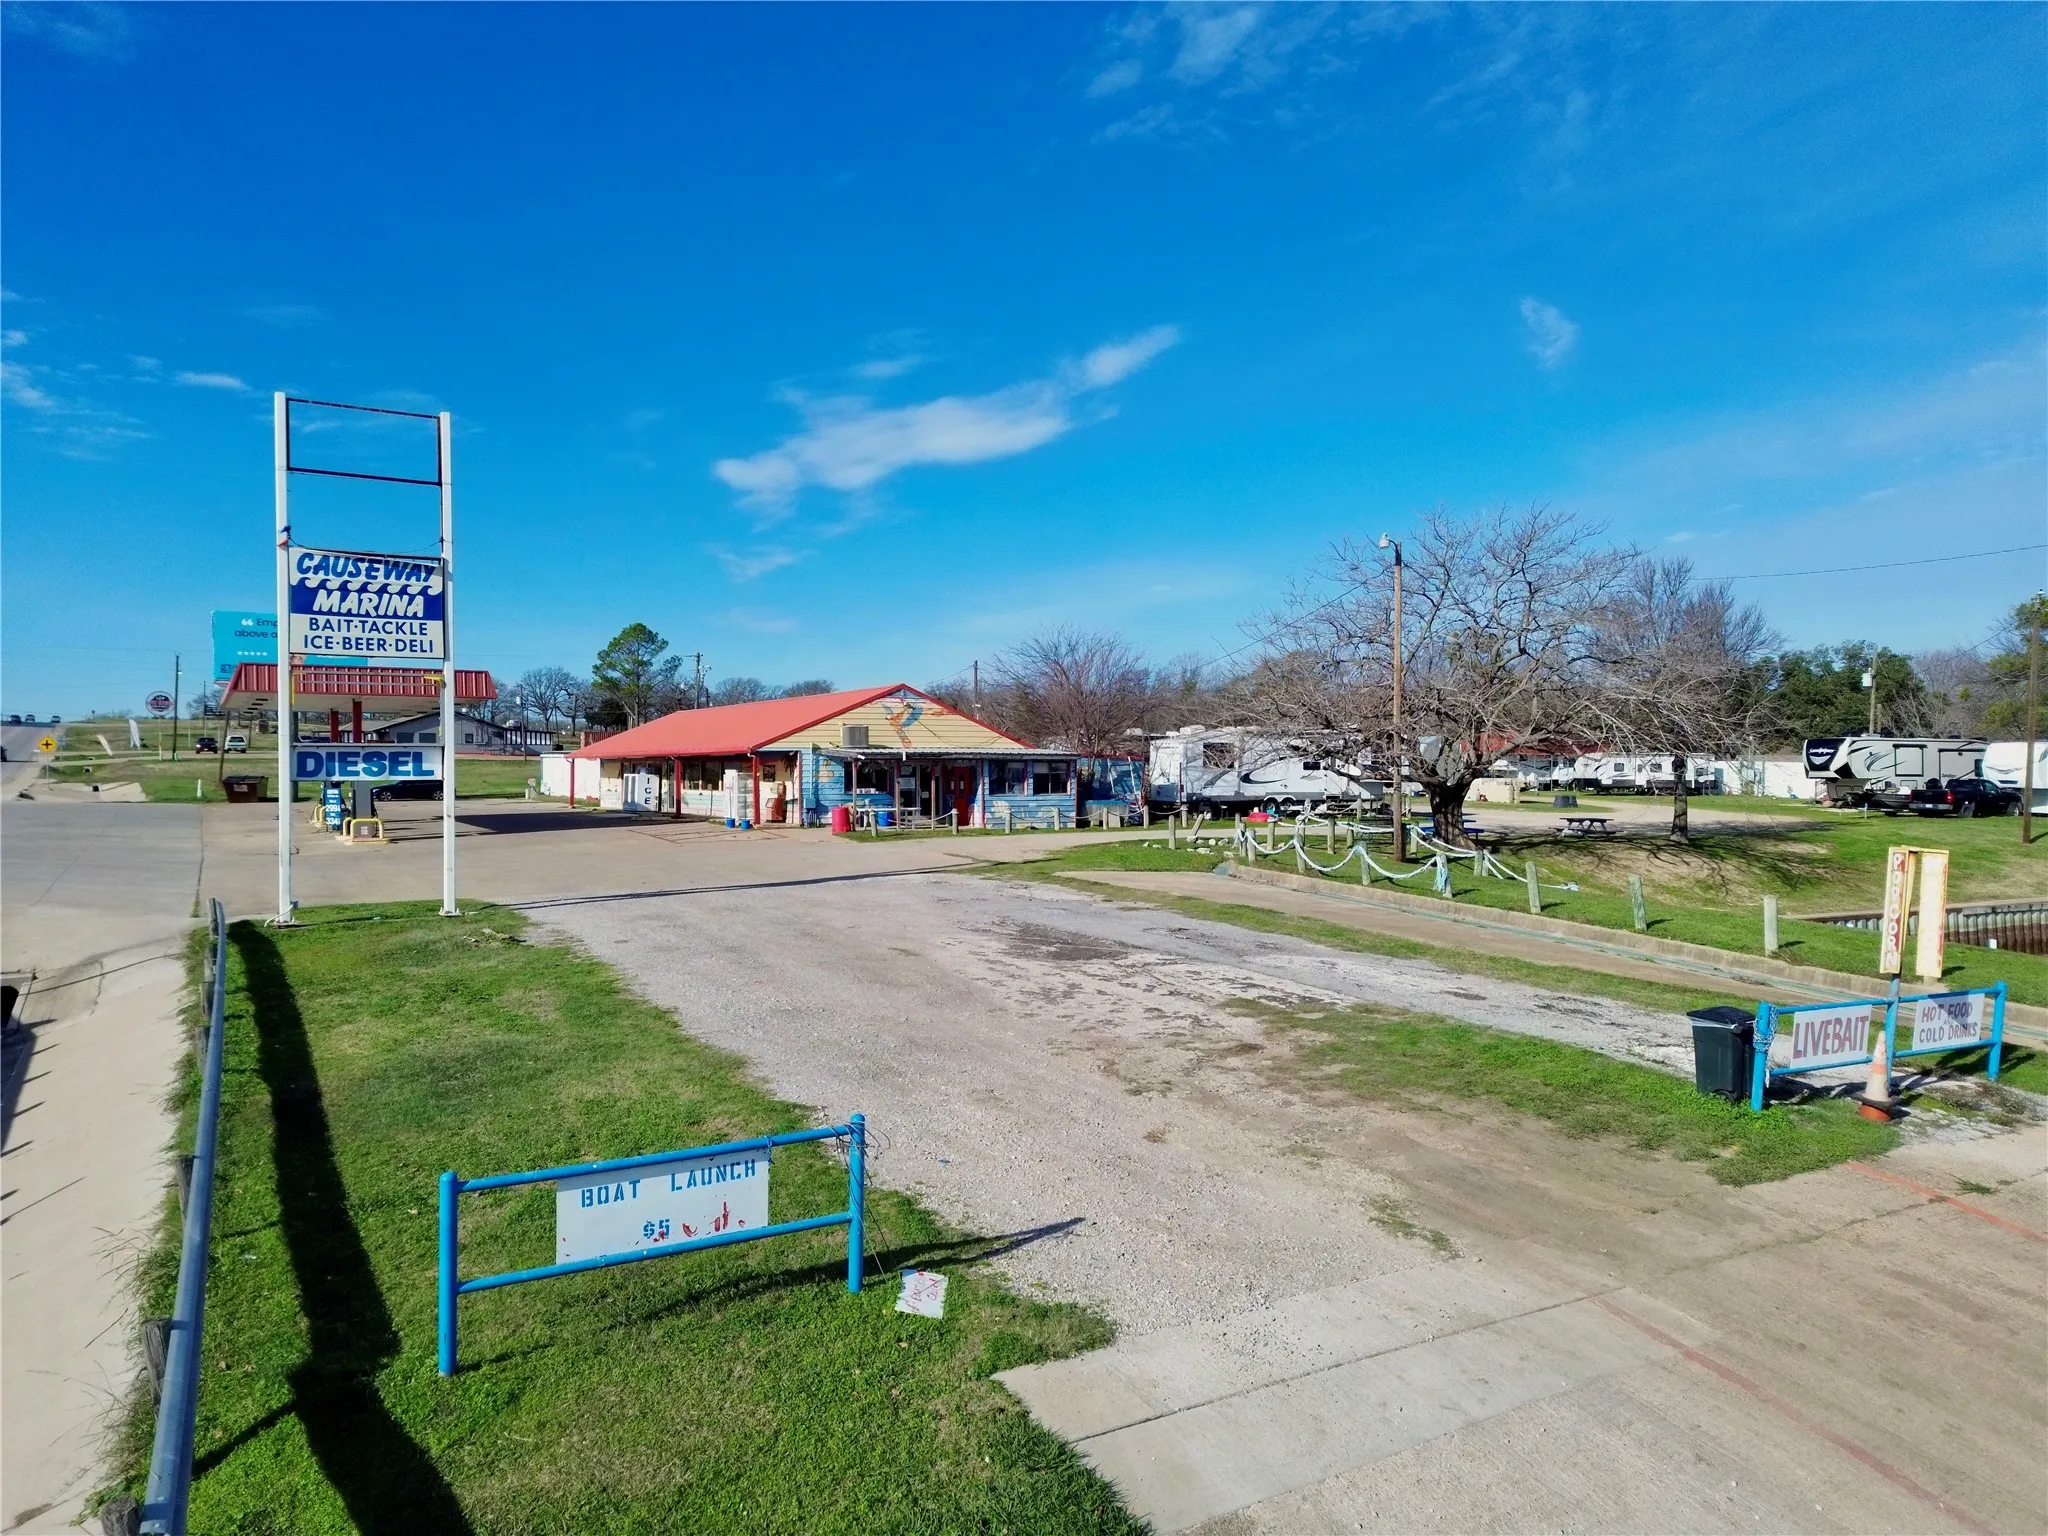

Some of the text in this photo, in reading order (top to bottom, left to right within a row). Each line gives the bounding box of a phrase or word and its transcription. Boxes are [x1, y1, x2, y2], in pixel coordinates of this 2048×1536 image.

[296, 552, 436, 583] CAUSEWAY
[312, 589, 425, 618] MARINA
[234, 629, 268, 638] above
[296, 750, 435, 778] DIESEL
[644, 777, 652, 805] ICE
[1922, 1002, 1973, 1023] HOT FOOD
[1919, 1021, 1978, 1043] COLD DRINKS
[581, 1158, 757, 1208] BOAT LAUNCH
[643, 1218, 670, 1240] $5
